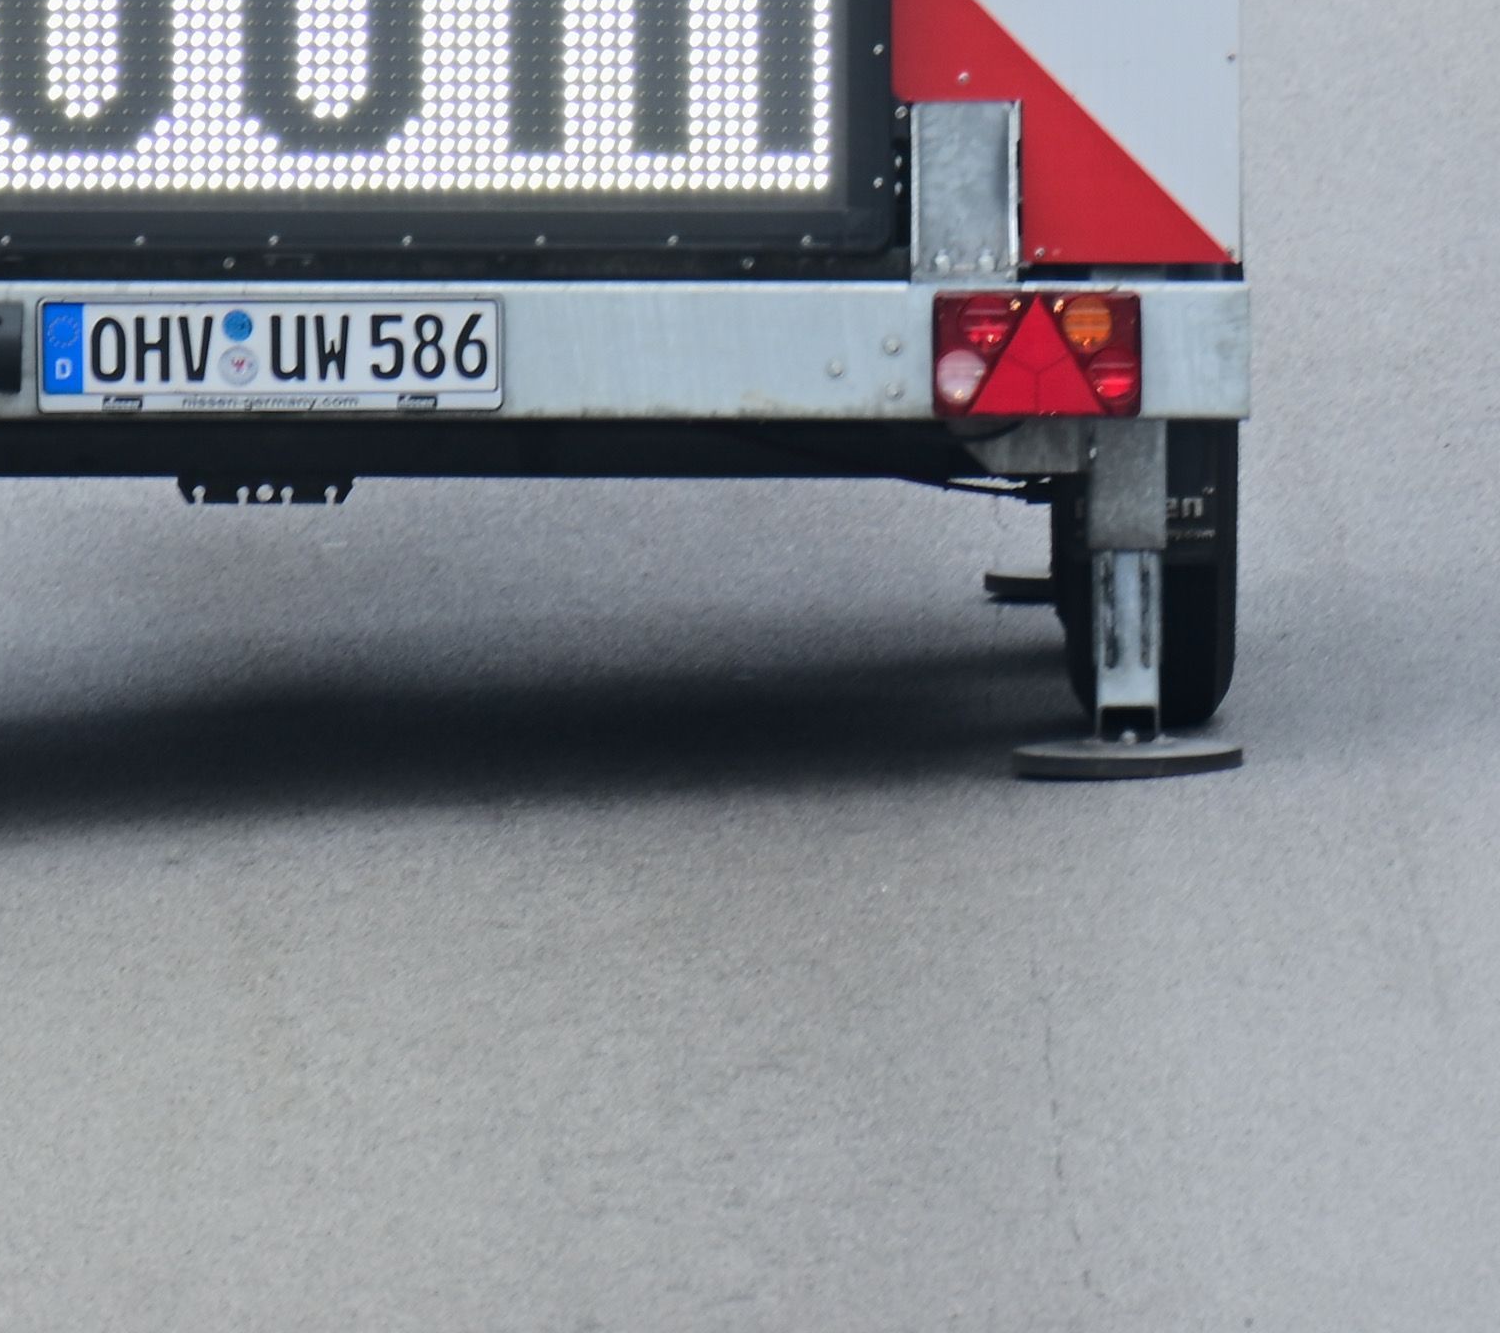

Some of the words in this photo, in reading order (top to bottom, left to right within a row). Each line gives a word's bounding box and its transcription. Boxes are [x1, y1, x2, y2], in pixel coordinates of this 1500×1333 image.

[55, 357, 73, 380] D
[91, 315, 213, 382] OHV
[270, 314, 349, 381] UW
[370, 313, 488, 380] 586
